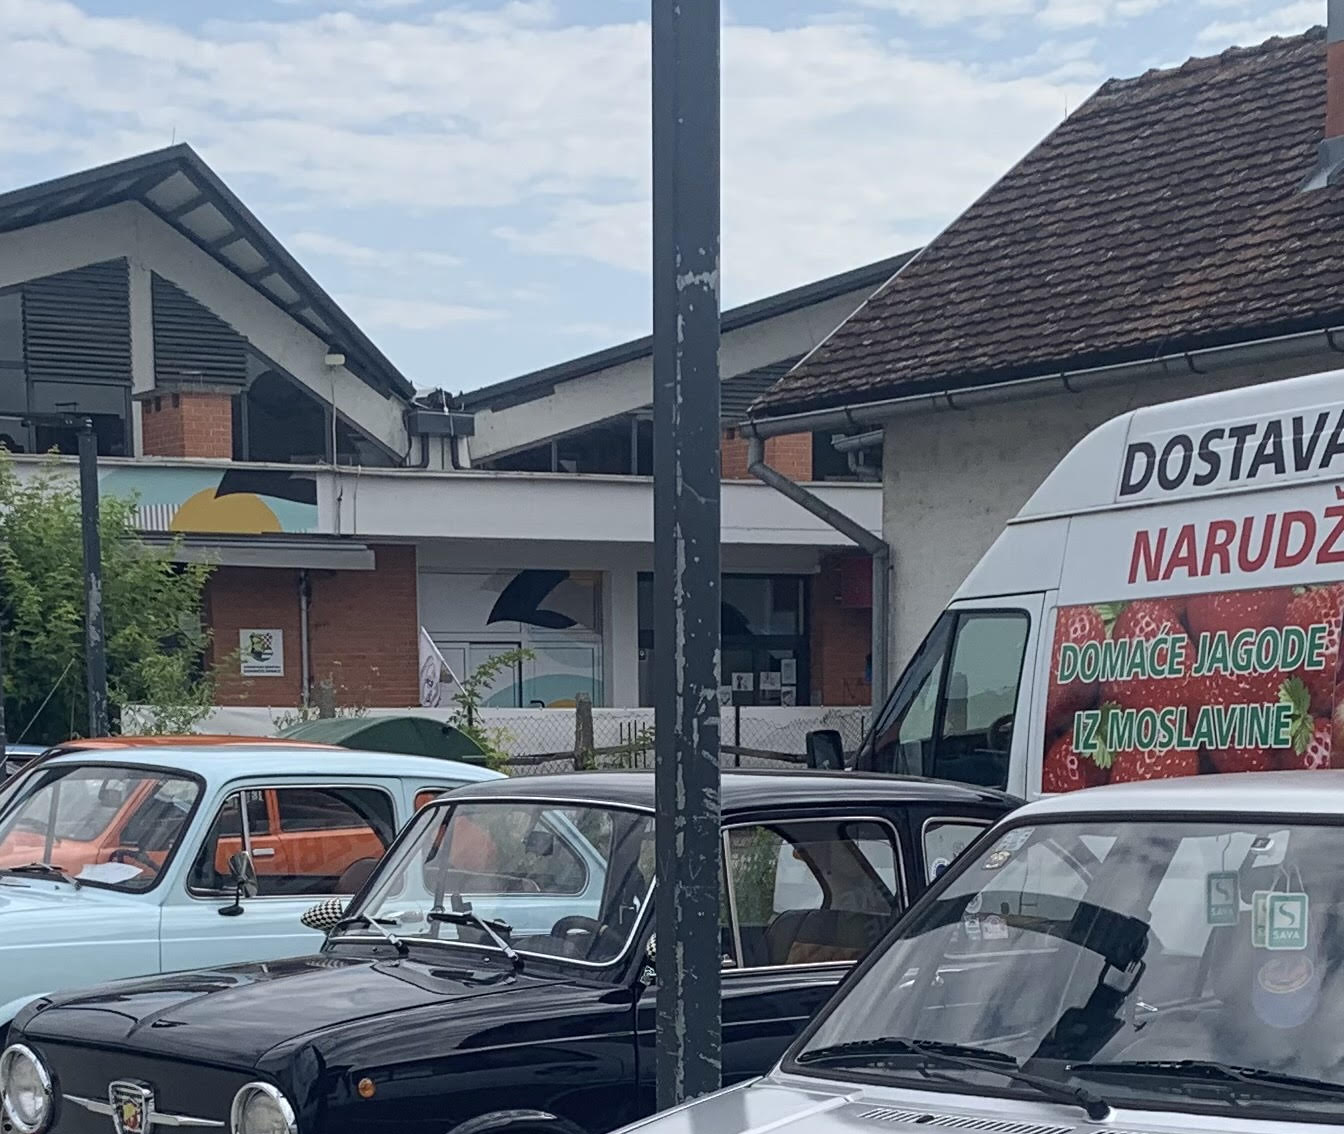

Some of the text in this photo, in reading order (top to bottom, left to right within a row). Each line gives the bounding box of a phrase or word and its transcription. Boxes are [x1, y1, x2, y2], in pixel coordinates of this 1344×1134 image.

[1057, 621, 1329, 685] DOMAĆE JAGODE
[1073, 702, 1294, 753] IZ MOSLAVINE
